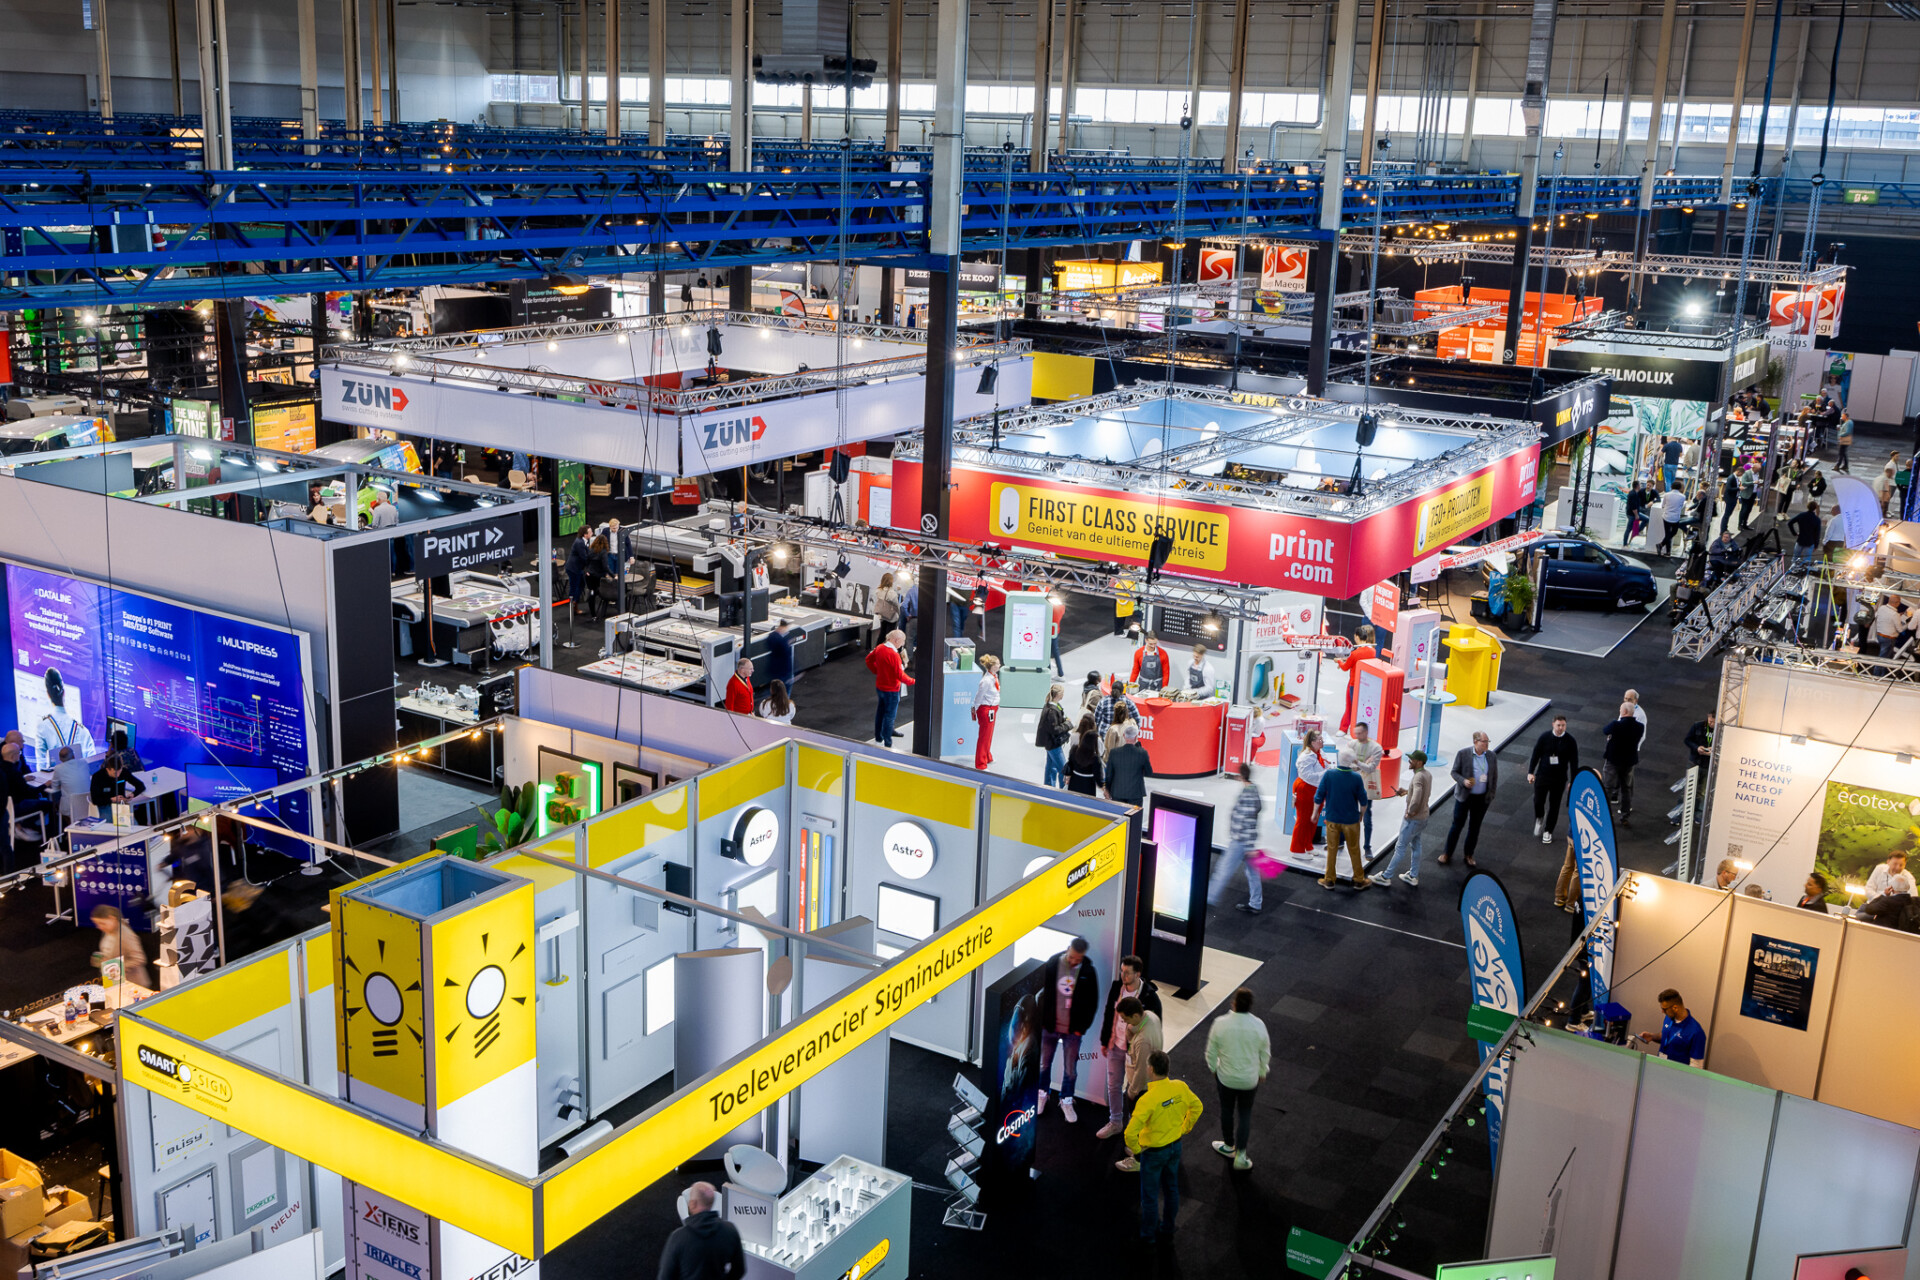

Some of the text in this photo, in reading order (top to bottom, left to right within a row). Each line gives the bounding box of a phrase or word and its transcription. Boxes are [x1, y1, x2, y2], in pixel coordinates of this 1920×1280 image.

[908, 270, 928, 278] DEZE
[972, 274, 995, 282] KOOP
[1274, 279, 1305, 291] Maegis
[1471, 298, 1491, 306] Maegis
[1816, 322, 1830, 334] egi
[174, 407, 206, 421] THE WRAP
[174, 418, 207, 438] ZONE
[1448, 486, 1481, 520] PRODUCTEN
[1029, 497, 1220, 549] FIRST CLASS SERVICE
[424, 531, 480, 558] PRINT
[1027, 522, 1205, 562] Geniet van de ultieme ntreis
[1269, 529, 1335, 564] print
[452, 546, 515, 569] EQUIPMENT
[1284, 562, 1333, 584] .com
[154, 620, 172, 631] PRINT
[1257, 613, 1291, 626] FREQUET
[1256, 626, 1276, 638] FLYER
[222, 636, 278, 658] MULTIPRESS
[1138, 729, 1154, 741] om
[1740, 757, 1793, 774] DISCOVER
[1738, 768, 1793, 785] THE MANY
[1736, 780, 1784, 796] FACES OF
[1735, 792, 1776, 808] NATURE
[1068, 864, 1089, 886] SMART
[1078, 908, 1106, 918] NIEUW
[710, 924, 994, 1123] Toeleverancier Signindustrie
[1078, 1052, 1099, 1061] IEUW
[140, 1048, 228, 1096] SMART SIGN
[996, 1104, 1036, 1145] Cosmos
[270, 1200, 300, 1234] NIEUW
[734, 1204, 767, 1216] NIEUW
[364, 1200, 419, 1240] X-TENS
[364, 1241, 422, 1280] TRIAFLEX
